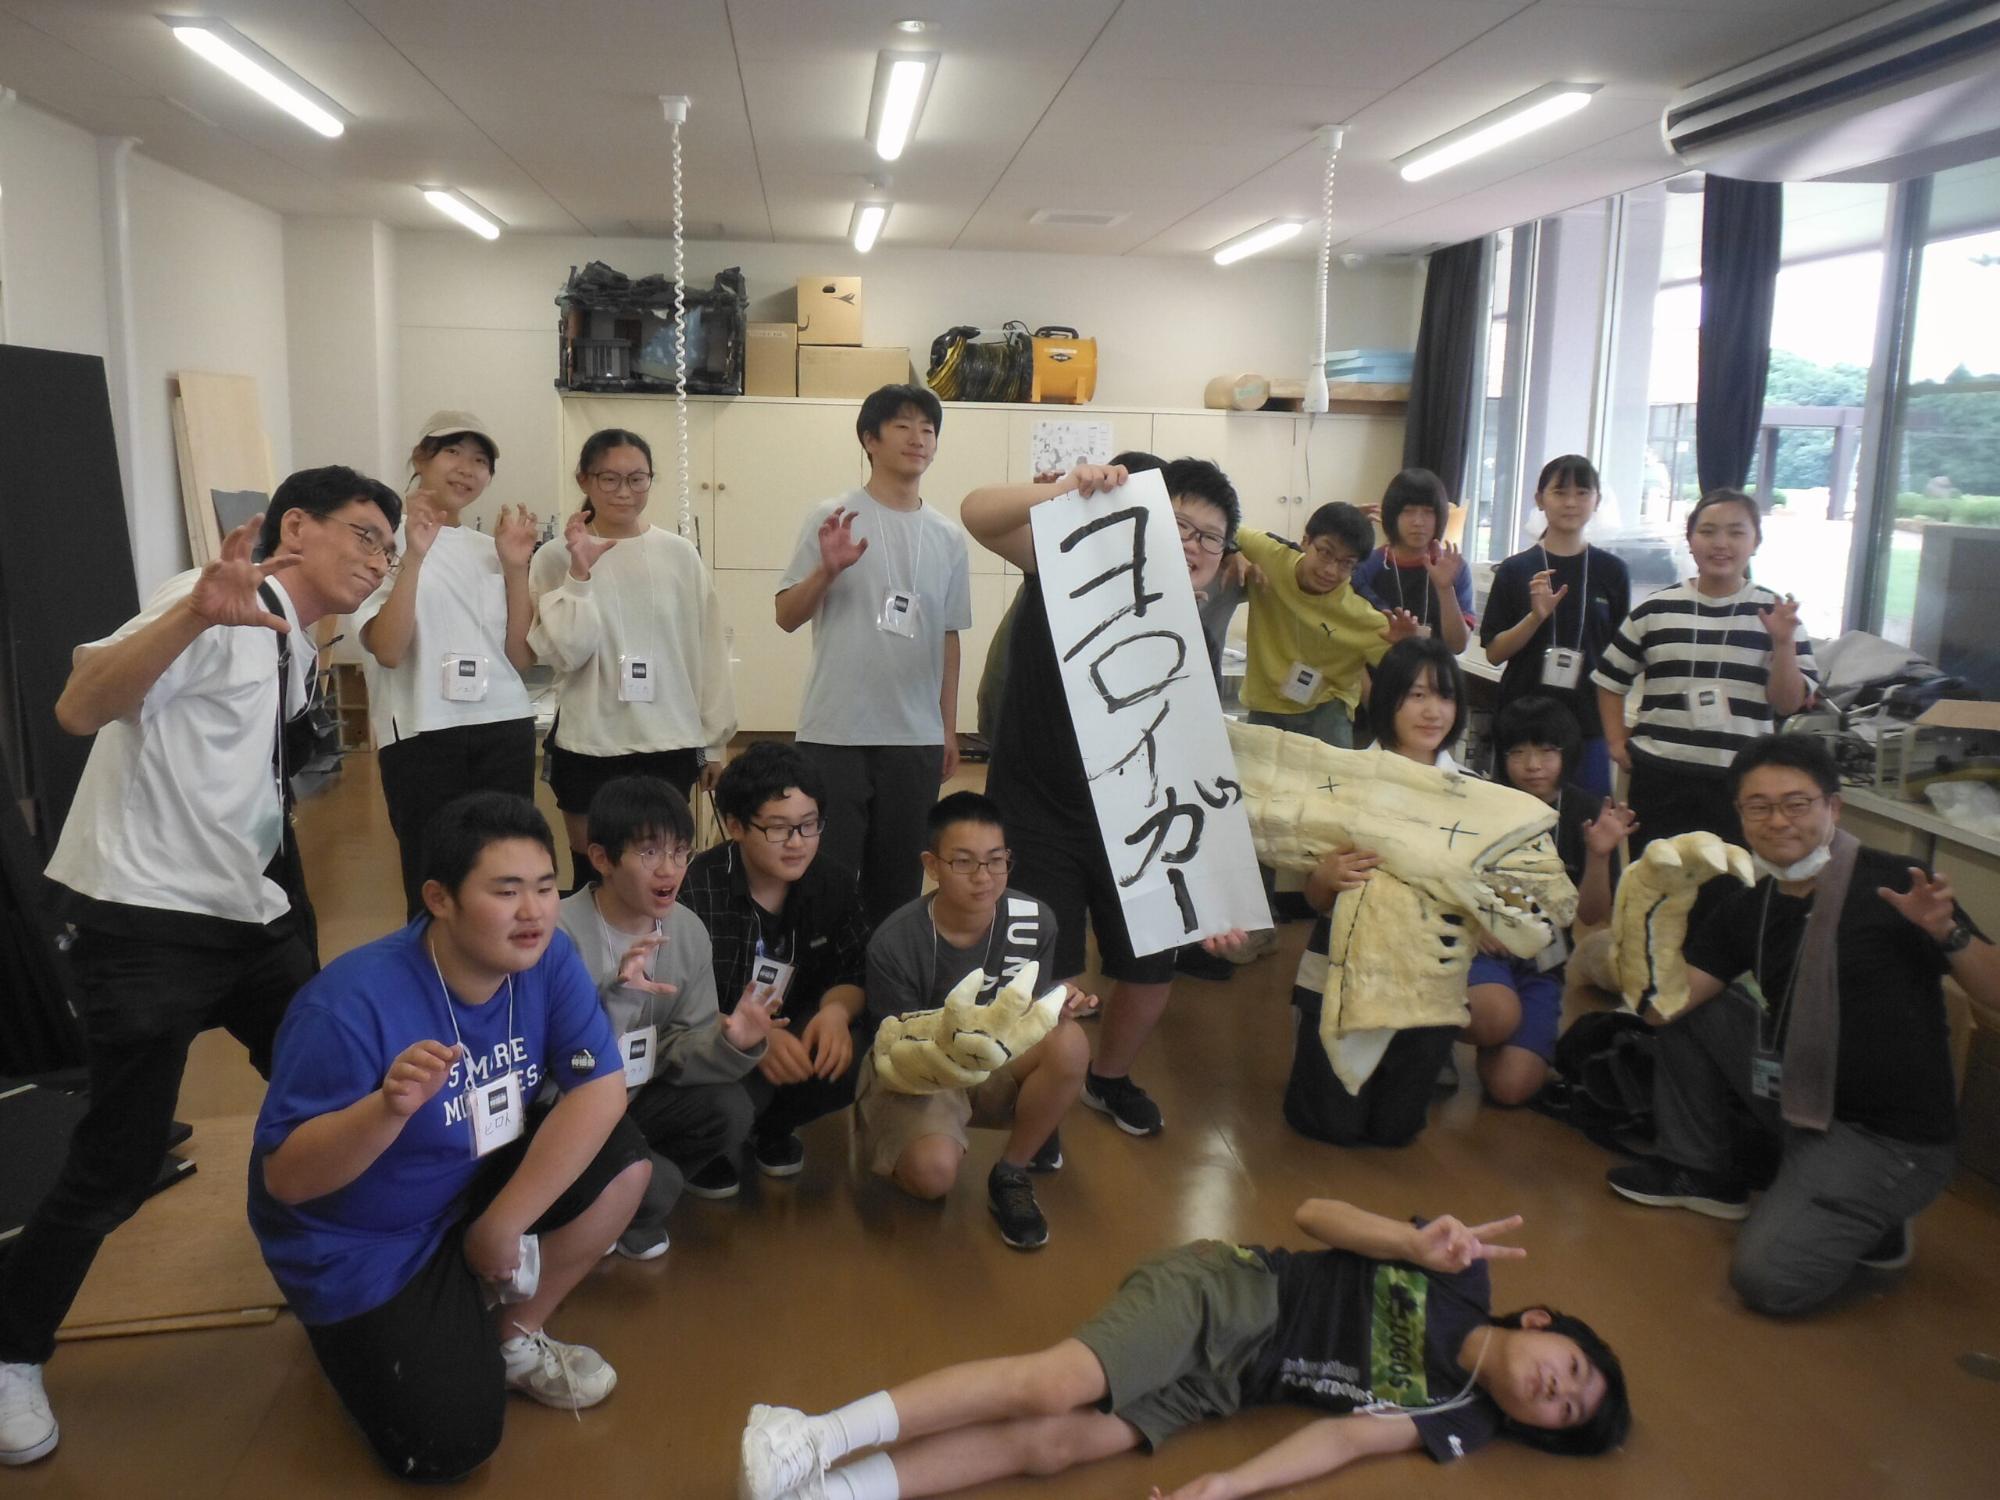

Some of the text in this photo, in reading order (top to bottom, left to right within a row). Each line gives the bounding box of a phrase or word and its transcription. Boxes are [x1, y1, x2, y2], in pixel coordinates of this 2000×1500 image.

[1060, 505, 1243, 935] ヨロイガー
[1388, 1320, 1414, 1390] LOGOS
